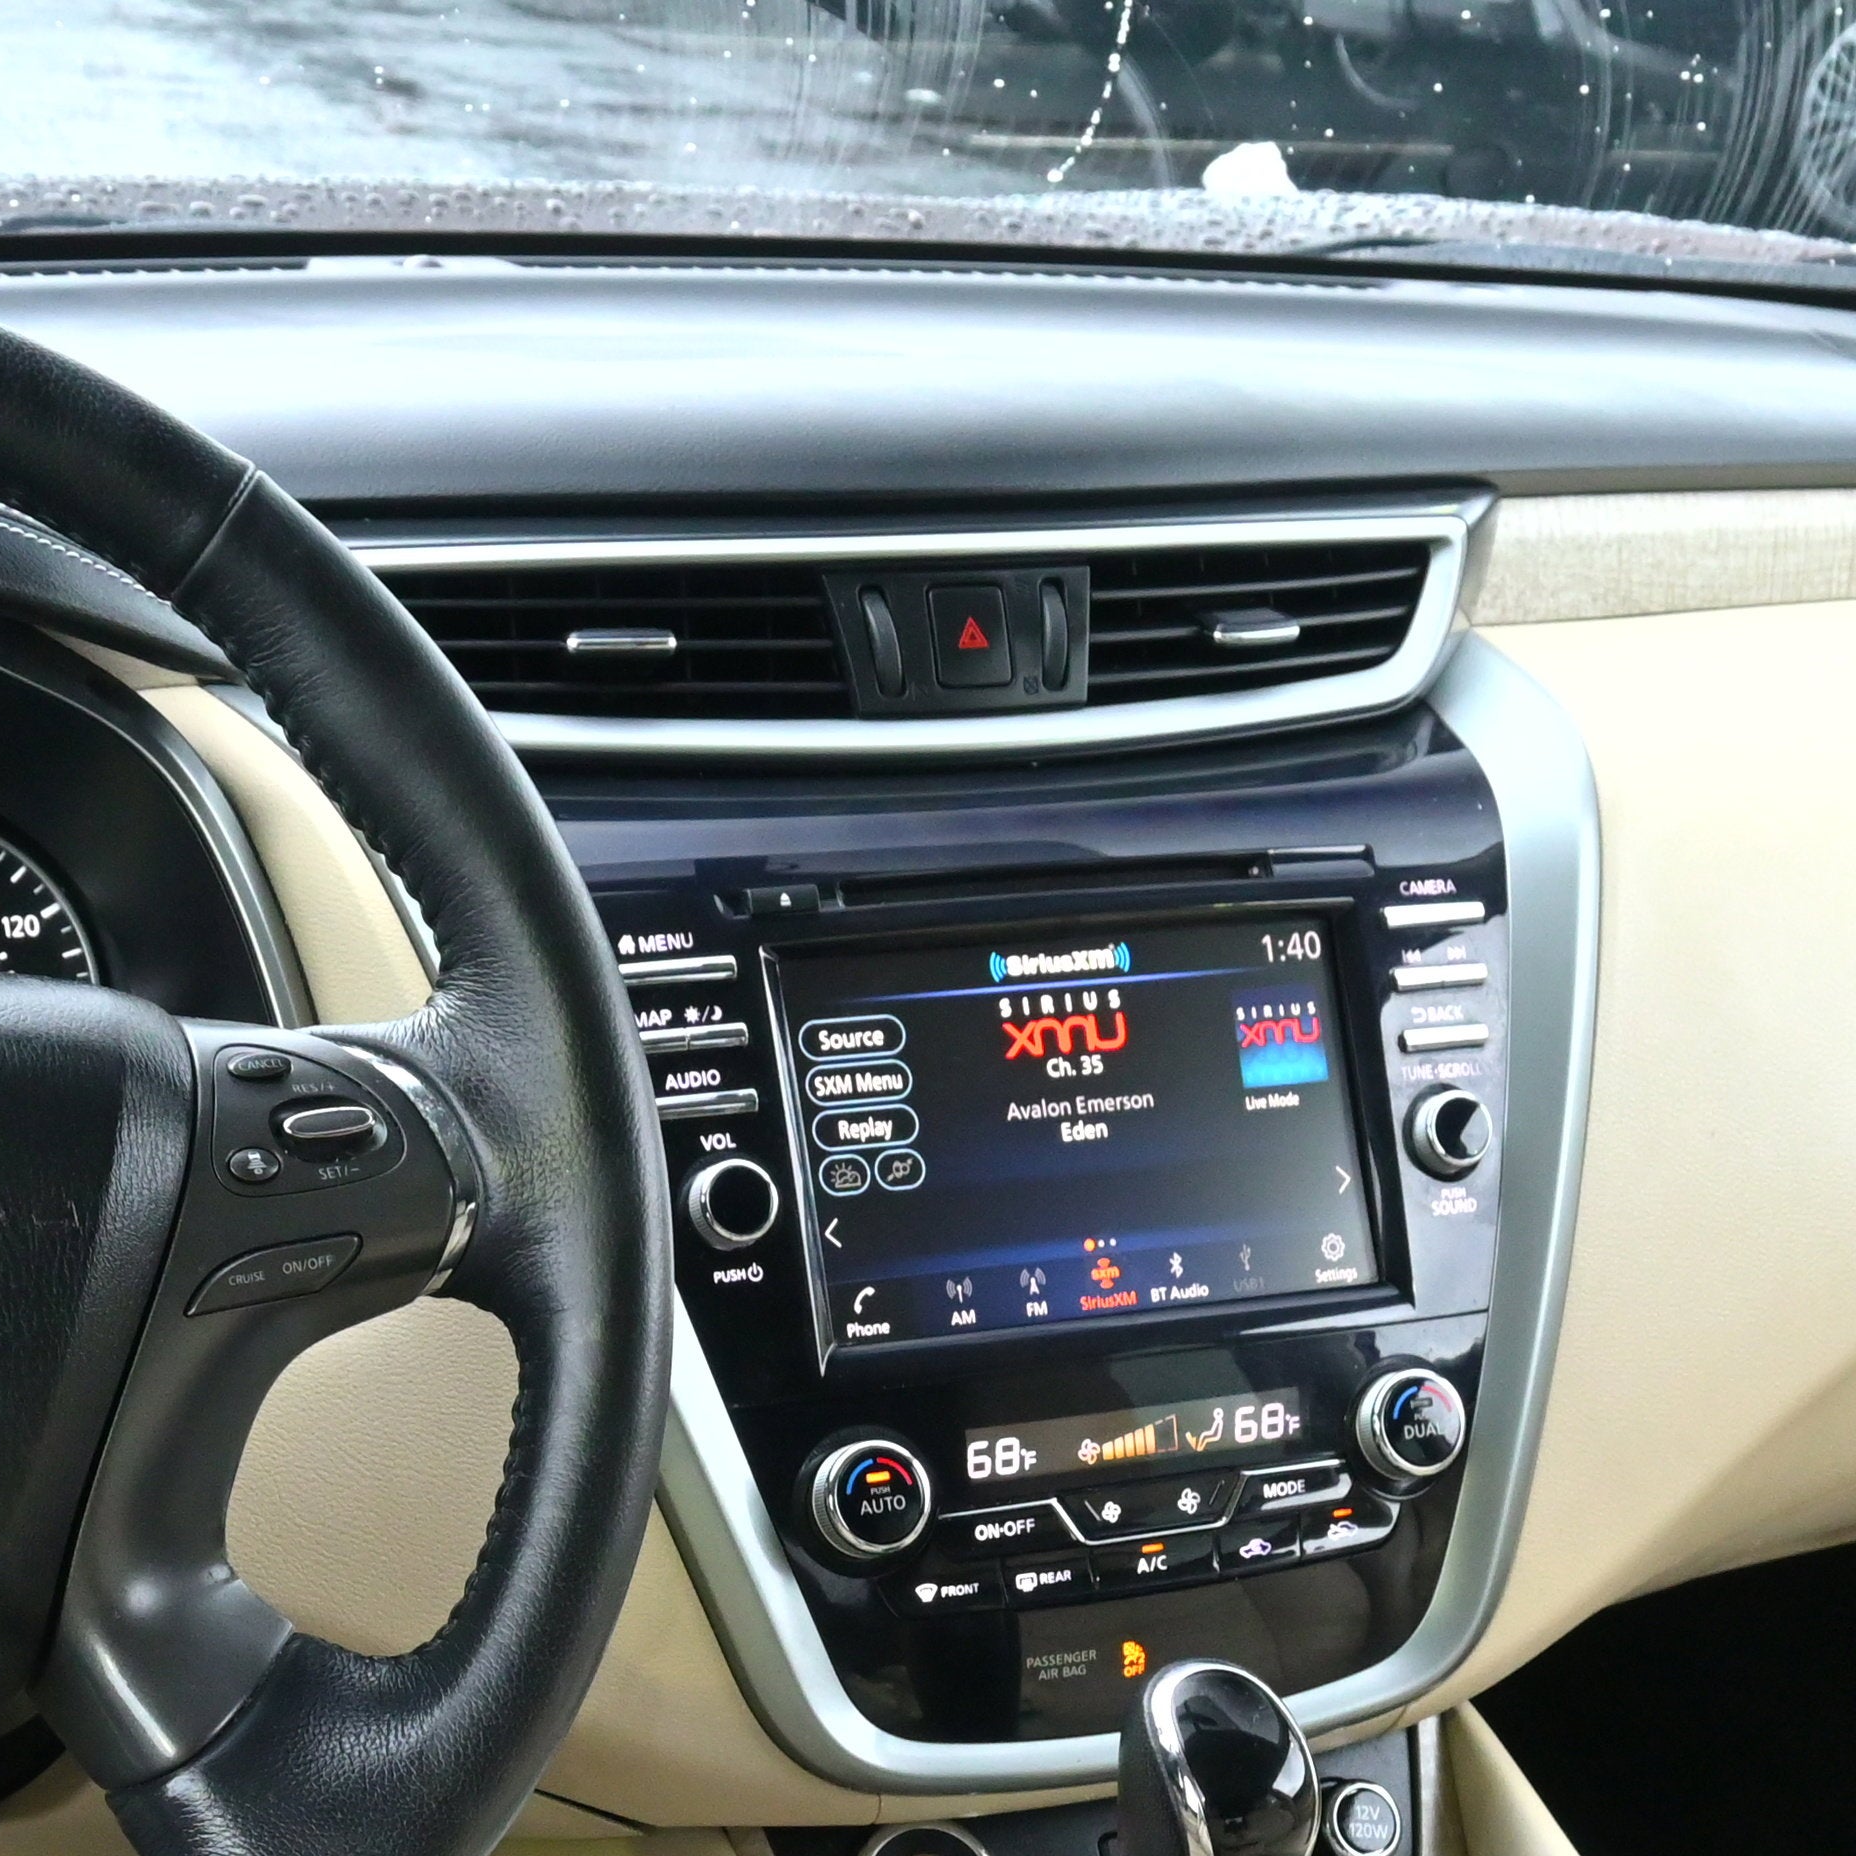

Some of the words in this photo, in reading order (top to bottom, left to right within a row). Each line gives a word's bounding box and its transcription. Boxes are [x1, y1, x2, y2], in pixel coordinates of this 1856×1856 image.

[1399, 878, 1457, 895] CAMERA
[1, 914, 41, 938] 120
[638, 932, 694, 953] MENU
[1262, 930, 1322, 963] 1:40
[999, 989, 1121, 1018] SIRIUS
[1236, 1001, 1316, 1021] SIRIUS
[1426, 1005, 1464, 1022] BACK
[818, 1030, 884, 1051] Source
[238, 1058, 283, 1071] CANCEL
[1046, 1056, 1077, 1079] Ch.
[1080, 1054, 1104, 1075] 35
[665, 1069, 721, 1091] AUDIO
[814, 1073, 853, 1097] SXM
[855, 1072, 903, 1093] Menu
[1006, 1098, 1072, 1122] Avalon
[1075, 1093, 1155, 1115] Emerson
[1245, 1094, 1268, 1111] Live
[1268, 1091, 1300, 1109] Mode
[838, 1116, 893, 1142] Replay
[1060, 1120, 1109, 1143] Eden
[700, 1132, 737, 1151] VOL
[1441, 1187, 1466, 1199] PUSH
[1431, 1198, 1477, 1216] SOUND
[281, 1253, 335, 1275] ON/OFF
[228, 1269, 265, 1287] CRUISE
[713, 1268, 746, 1284] PUSH
[1315, 1266, 1358, 1284] Settings
[1080, 1291, 1138, 1311] SiriusXM
[1150, 1287, 1167, 1303] BT
[1170, 1282, 1209, 1300] Audio
[951, 1309, 976, 1327] AM
[1026, 1300, 1048, 1318] FM
[846, 1321, 891, 1339] Phone
[1404, 1422, 1444, 1440] DUAL
[870, 1486, 891, 1495] PUSH
[1263, 1479, 1306, 1499] MODE
[860, 1494, 906, 1516] AUTO
[1137, 1555, 1168, 1574] A/C
[1039, 1569, 1072, 1585] REAR
[940, 1583, 980, 1598] FRONT
[1026, 1650, 1097, 1669] PASSENGER
[1039, 1669, 1059, 1681] AIR
[1062, 1665, 1087, 1678] BAG
[1356, 1805, 1380, 1820] 12V
[1349, 1823, 1388, 1839] 120W
